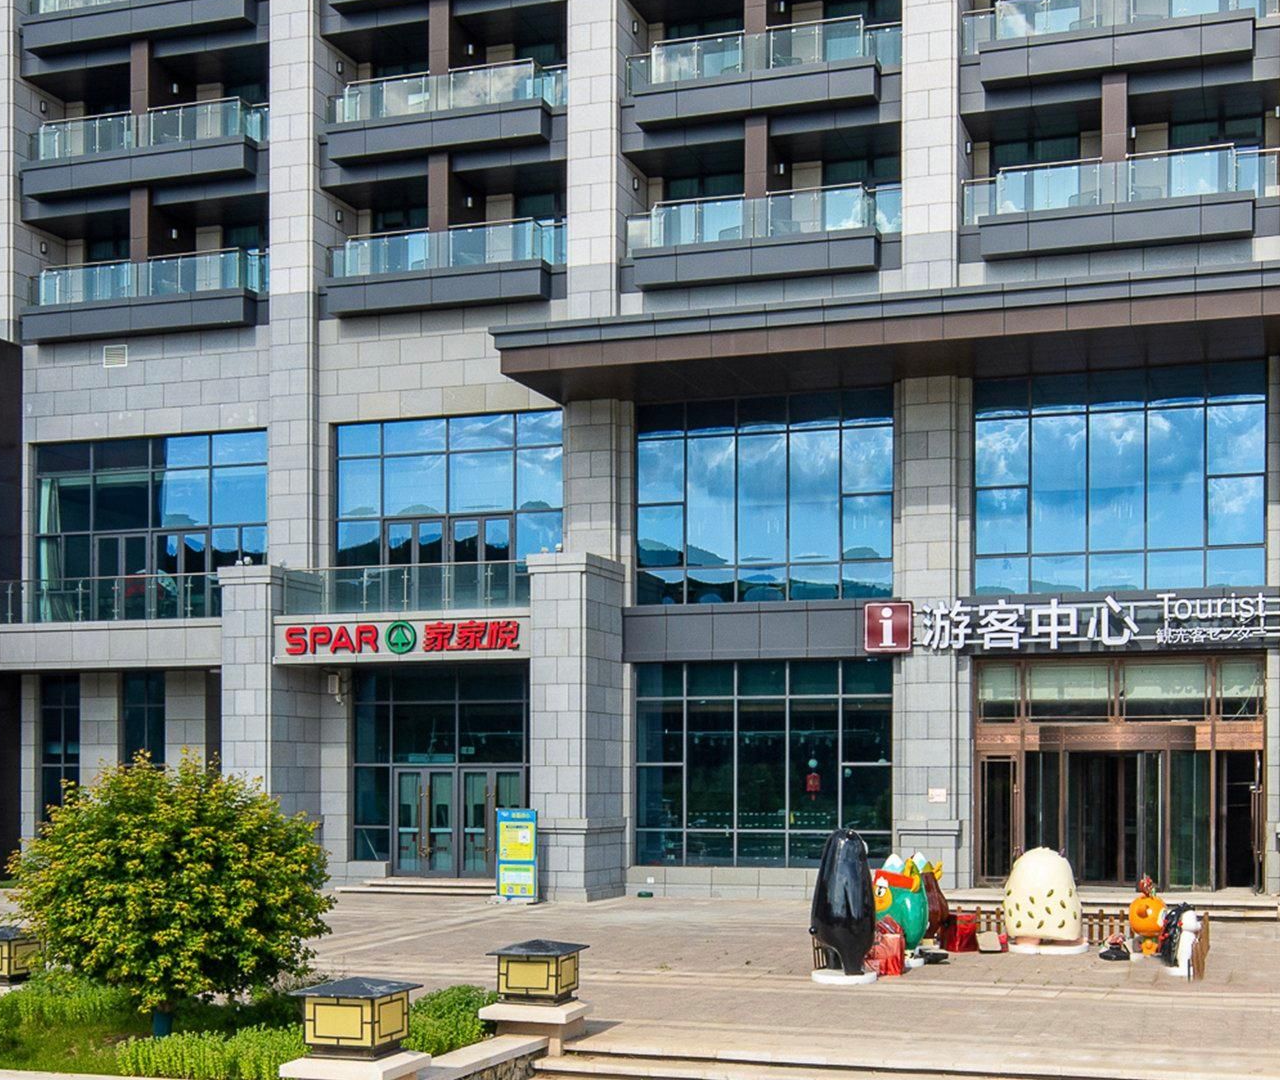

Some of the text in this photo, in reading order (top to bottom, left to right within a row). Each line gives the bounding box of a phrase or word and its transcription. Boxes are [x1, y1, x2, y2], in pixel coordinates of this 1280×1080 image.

[1156, 592, 1266, 621] Tourist
[422, 620, 521, 651] 家家悦
[922, 595, 1140, 650] 游客中心
[285, 625, 379, 655] SPAR
